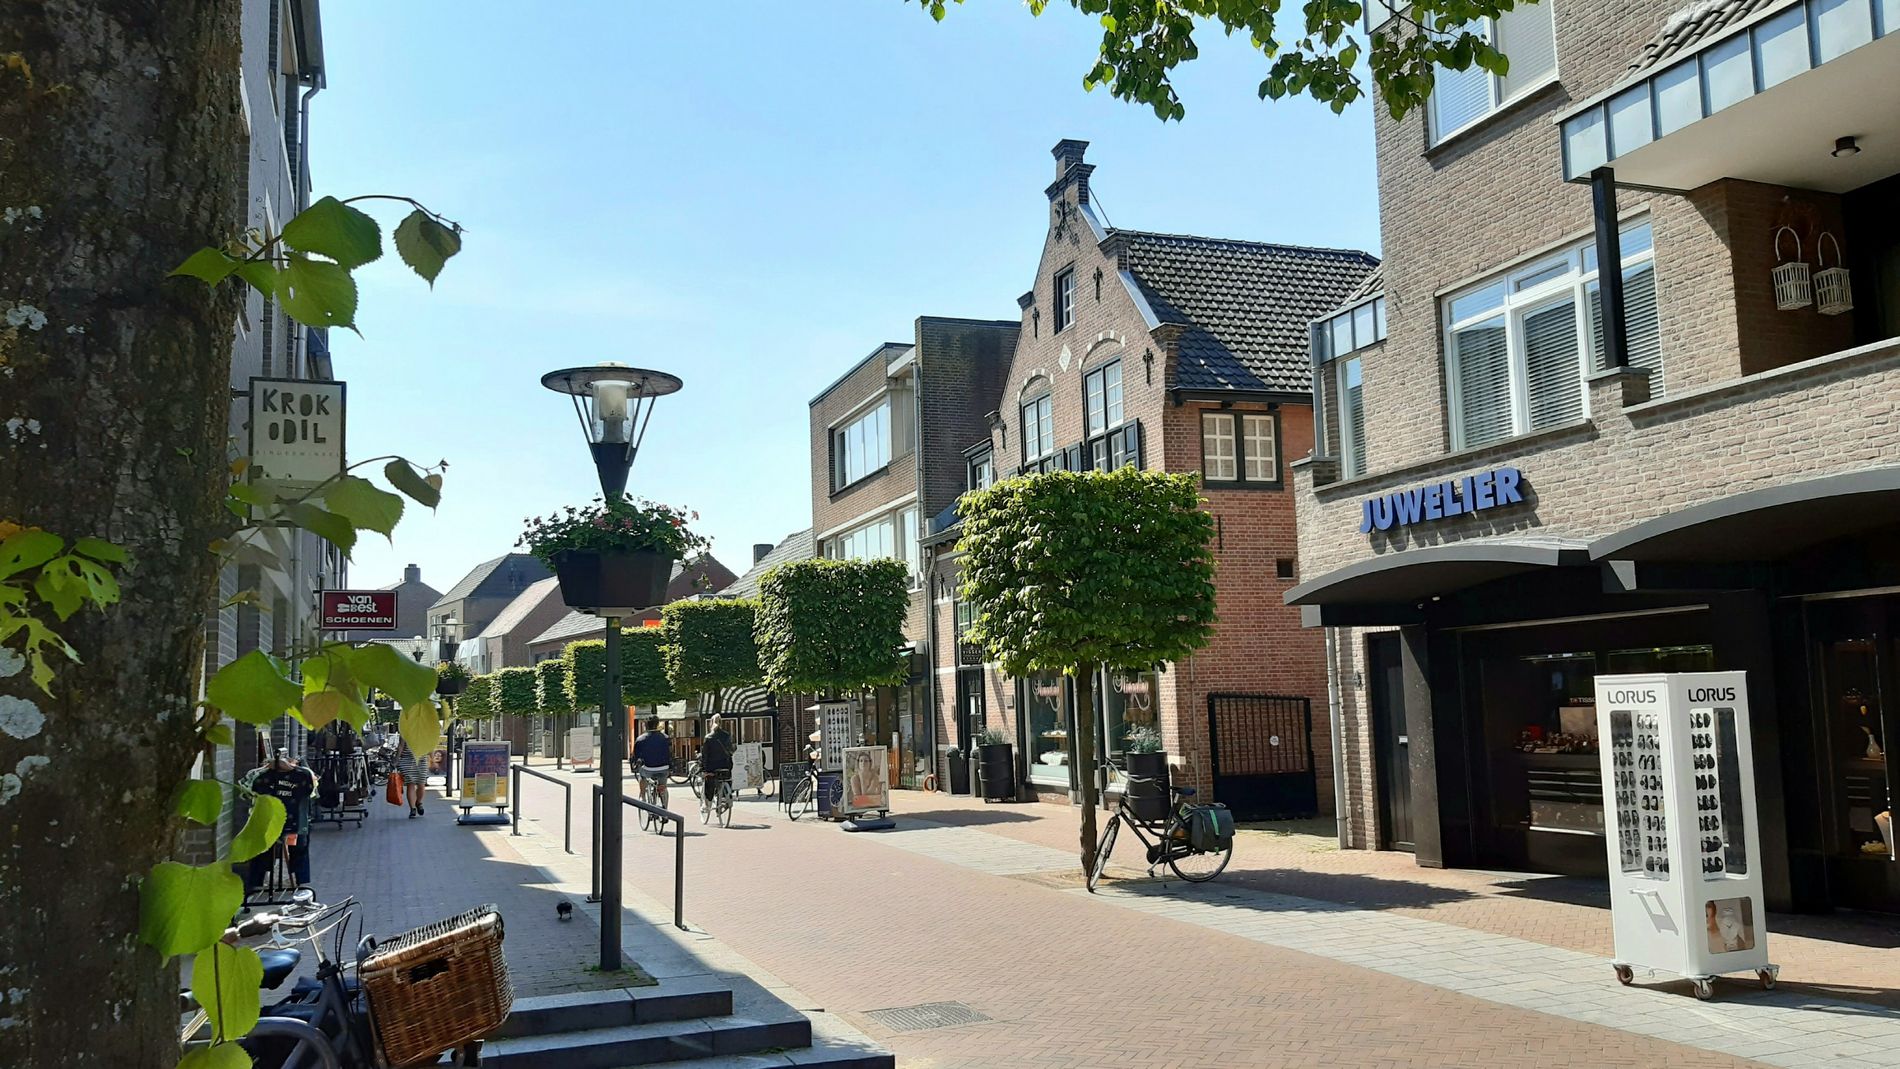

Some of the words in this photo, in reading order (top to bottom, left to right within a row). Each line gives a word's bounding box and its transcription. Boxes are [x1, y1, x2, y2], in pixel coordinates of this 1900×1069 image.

[262, 388, 330, 417] KROK
[268, 418, 327, 444] ODIL
[1360, 467, 1523, 534] JUWELIER
[347, 595, 373, 604] van
[325, 616, 392, 624] SCHOENEN
[1607, 690, 1657, 704] LORUS
[1688, 687, 1736, 702] LORUS
